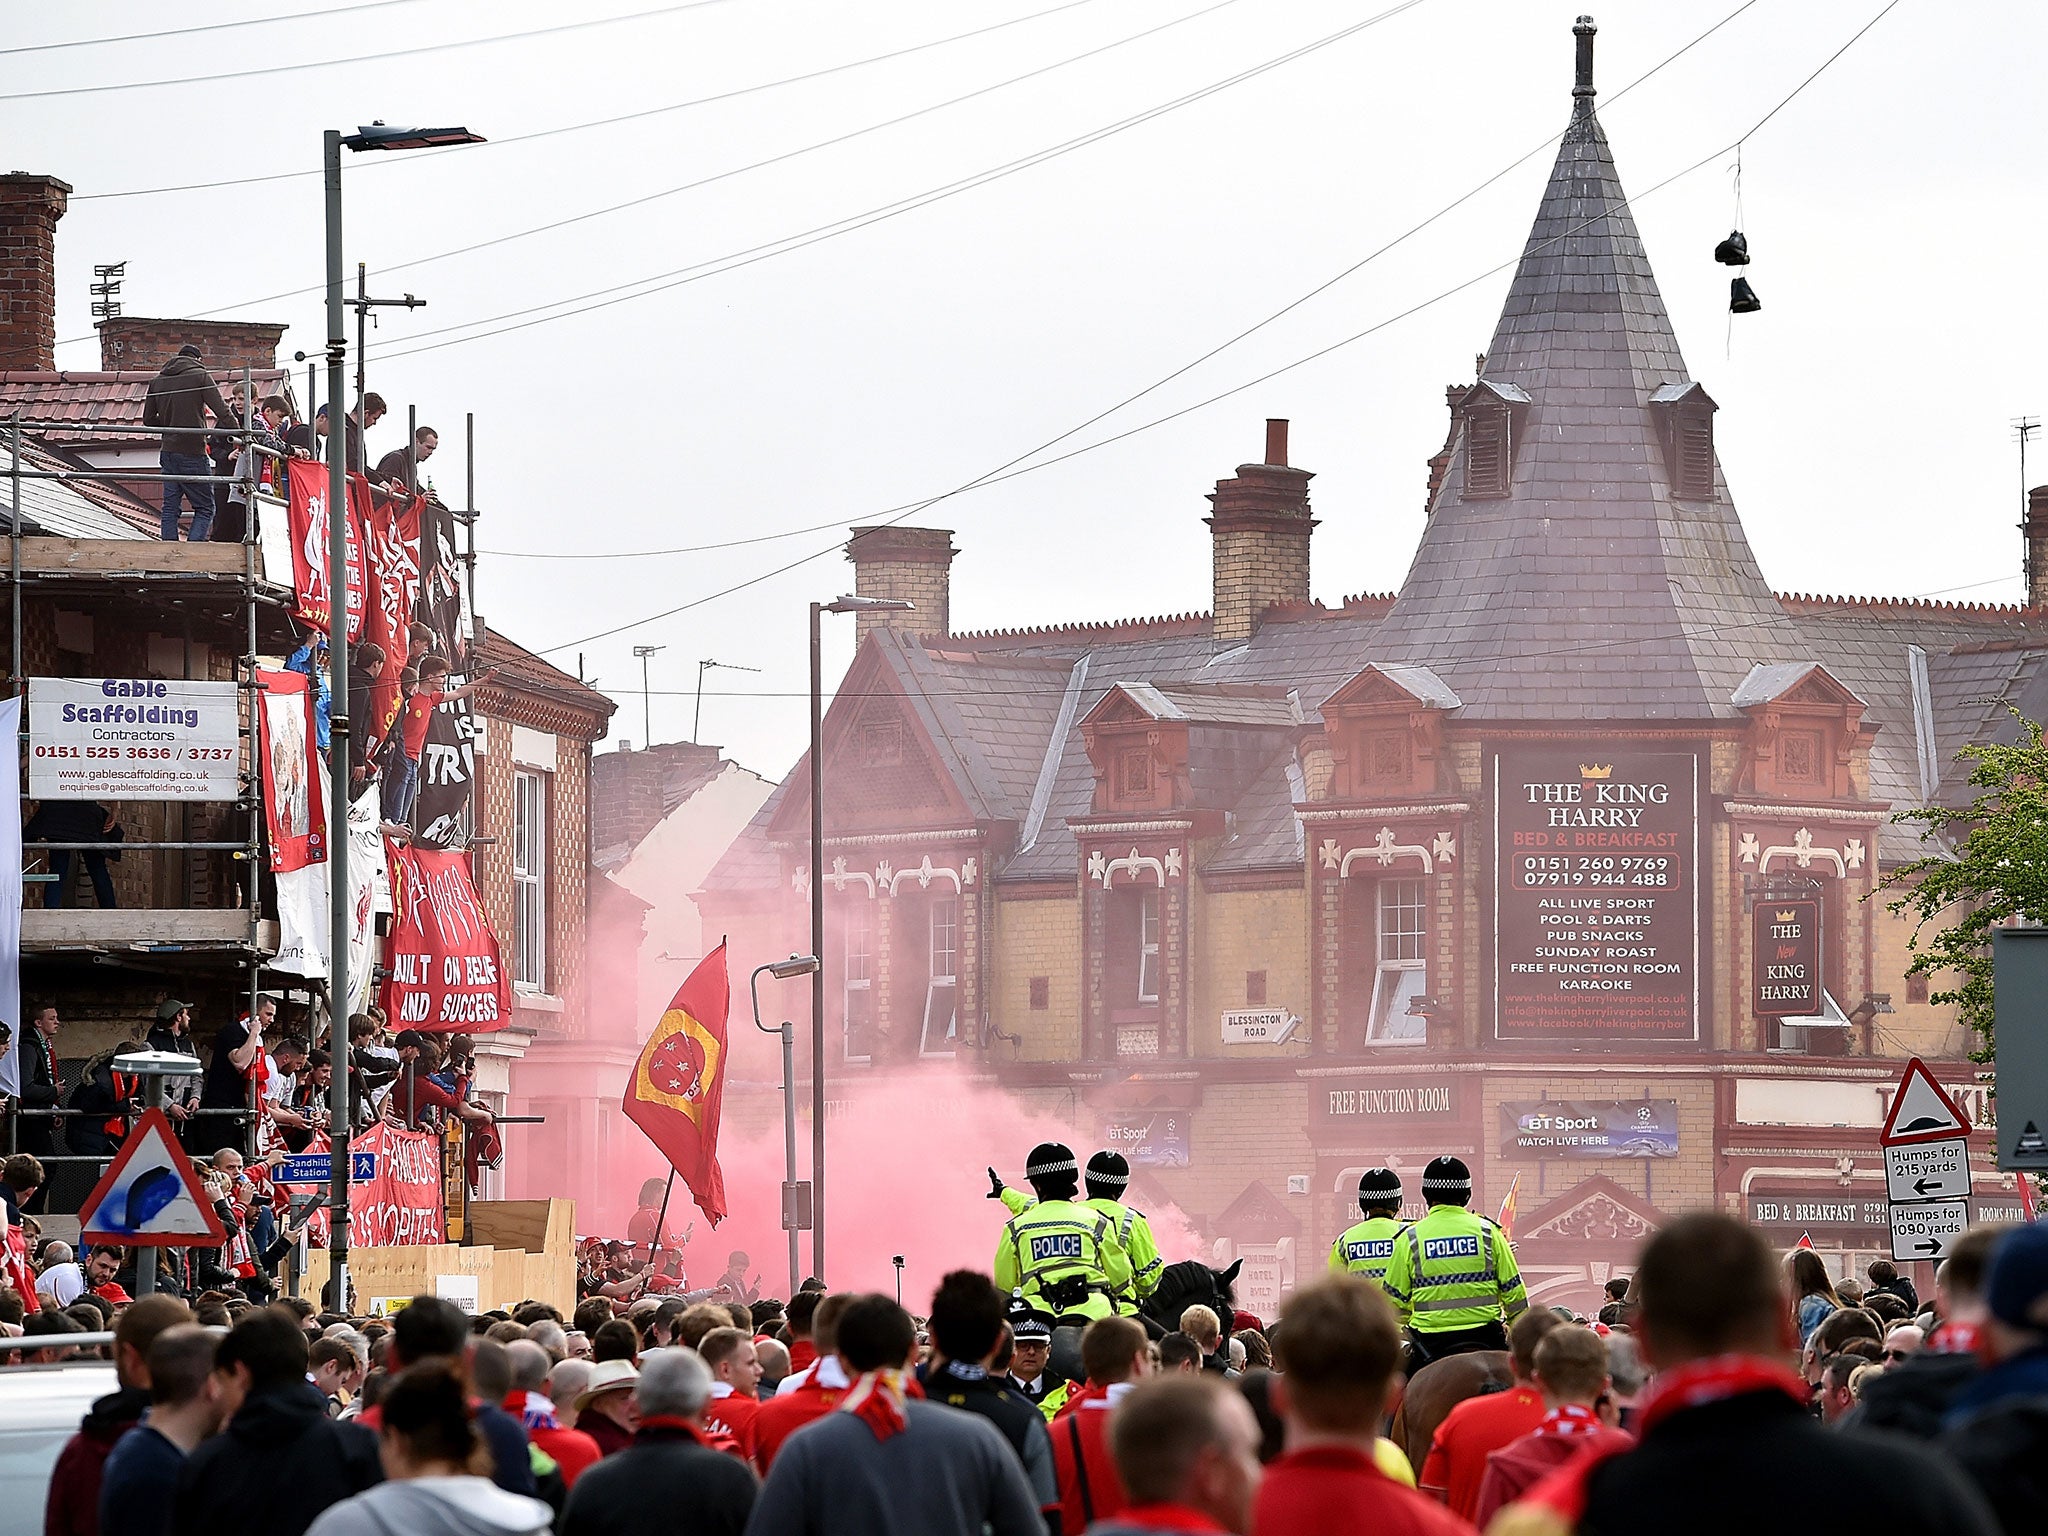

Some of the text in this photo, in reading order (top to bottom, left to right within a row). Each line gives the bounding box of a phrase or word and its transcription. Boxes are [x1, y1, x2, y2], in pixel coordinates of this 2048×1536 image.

[101, 679, 167, 698] Gable
[62, 703, 198, 728] Scaffolding
[92, 728, 175, 741] Contractors
[35, 746, 233, 760] 0151 525 3636 / 3737
[58, 769, 209, 781] www.gablescaffolding.co.uk
[59, 783, 209, 793] enquiries@gablescaffolding.co.uk
[1523, 783, 1582, 803] THE
[1596, 783, 1669, 804] KING
[1548, 807, 1644, 827] HARRY
[1513, 832, 1678, 847] BED & BREAKFAST
[1524, 857, 1668, 870] 0151 260 9769
[1524, 872, 1668, 886] 07919 944 488
[1538, 899, 1655, 909] ALL LIVE SPORT
[1540, 915, 1651, 925] POOL & DARTS
[1547, 931, 1644, 941] PUB SNACKS
[1770, 925, 1801, 938] THE
[1535, 947, 1657, 957] SUNDAY ROAST
[1776, 944, 1797, 960] New
[443, 955, 461, 986] ON
[1510, 963, 1681, 974] FREE FUNCTION ROOM
[1767, 964, 1805, 979] KING
[1560, 980, 1632, 990] KARAOKE
[1505, 993, 1687, 1006] www.thekingharryliverpool.co.uk
[1761, 985, 1811, 1000] HARRY
[400, 991, 499, 1023] AND SUCCESS
[1504, 1006, 1687, 1018] info@thekingharryliverpool.co.uk
[1228, 1014, 1281, 1026] BLESSINGTON
[1507, 1019, 1686, 1031] www.facebook/thekingharrybar
[1244, 1028, 1267, 1037] ROAD
[1329, 1087, 1450, 1115] FREE FUNCTION ROOM
[1528, 1116, 1598, 1132] BT Sport
[1109, 1126, 1147, 1141] BT Sport
[1517, 1136, 1609, 1146] WATCH LIVE HERE
[380, 1128, 437, 1185] FAMOUS
[1123, 1146, 1136, 1155] LIVE
[1136, 1146, 1153, 1155] HERE
[1891, 1146, 1960, 1163] Humps for
[288, 1158, 332, 1168] Sandhills
[1895, 1160, 1957, 1177] 215 yards
[293, 1168, 328, 1177] Station
[1756, 1203, 1857, 1222] BED & BREAKFAST
[1864, 1214, 1886, 1224] 0151
[1896, 1208, 1961, 1222] Humps for
[1979, 1207, 2003, 1222] ROOMS
[1892, 1222, 1961, 1236] 1090 yards
[1032, 1236, 1080, 1259] POLICE
[1348, 1241, 1392, 1258] POLICE
[1426, 1237, 1477, 1259] POLICE
[1248, 1270, 1274, 1281] HOTEL
